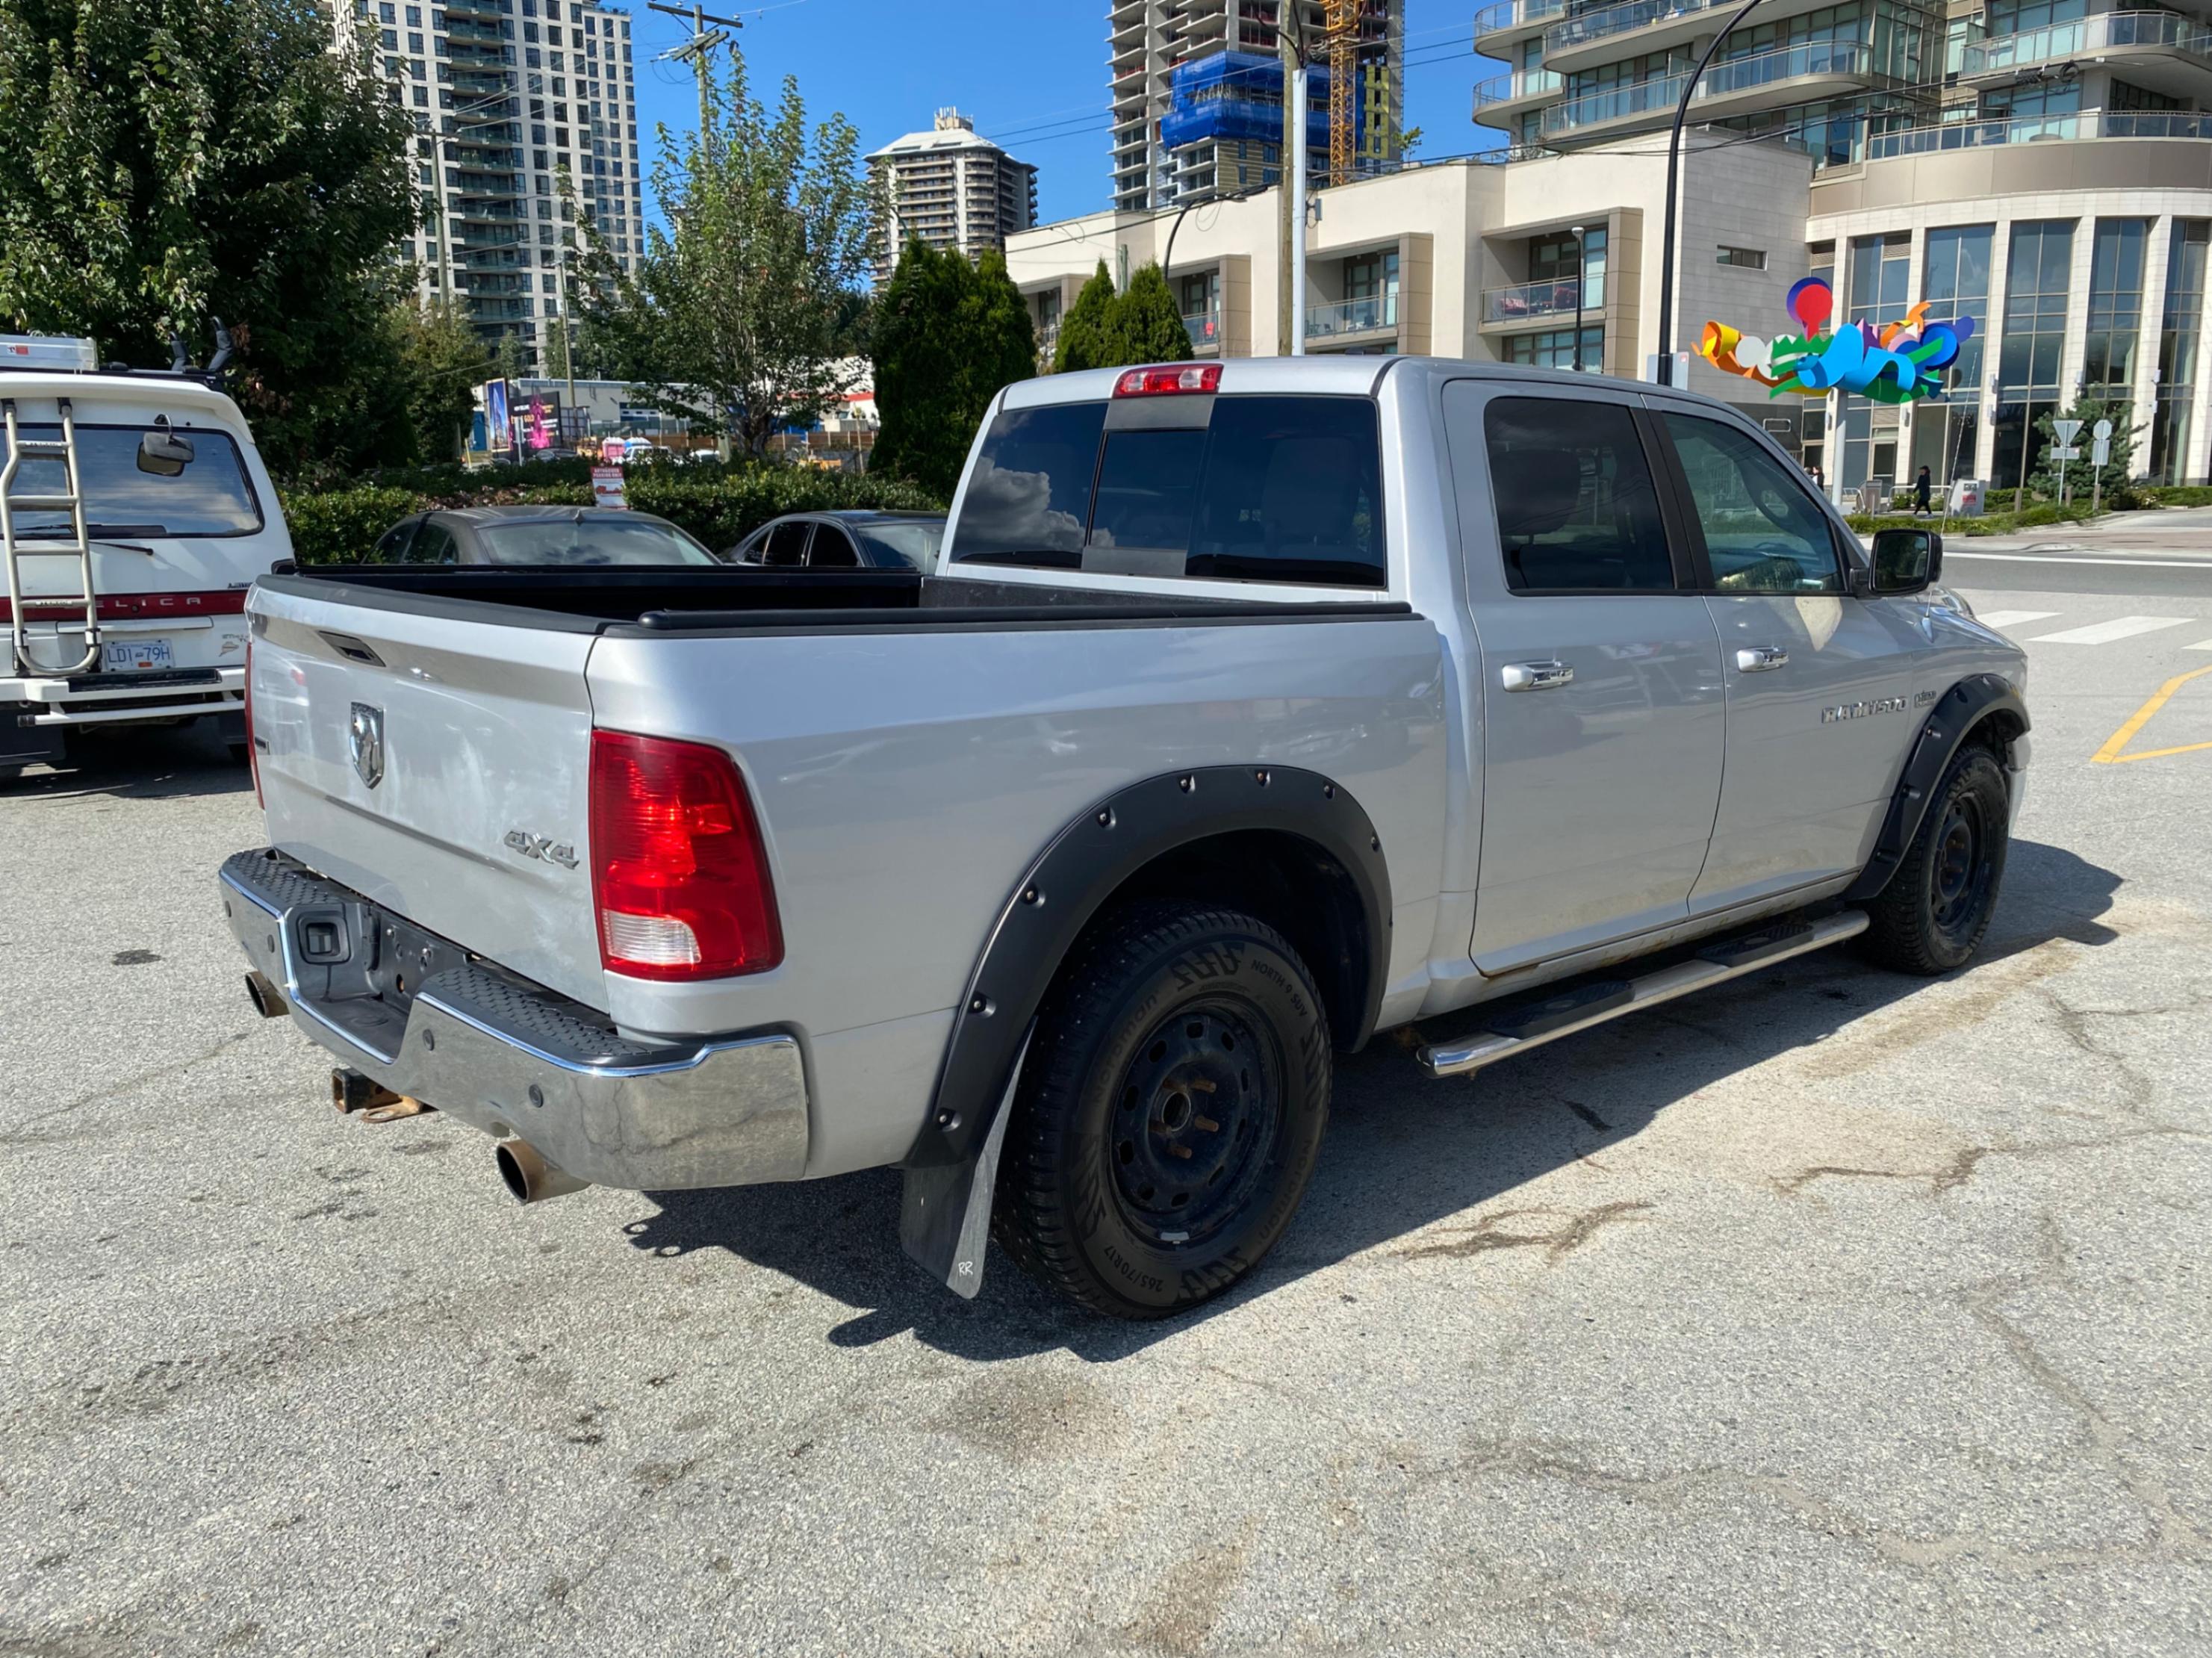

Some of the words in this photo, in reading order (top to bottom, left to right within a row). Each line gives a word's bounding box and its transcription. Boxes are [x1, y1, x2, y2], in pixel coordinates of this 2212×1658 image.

[95, 597, 201, 608] ELICA
[143, 646, 170, 661] 79H
[1821, 701, 1867, 724] RAM
[1251, 959, 1285, 988] NORTH
[1284, 984, 1293, 994] 9
[1290, 993, 1308, 1016] SUV
[958, 1261, 974, 1277] RR
